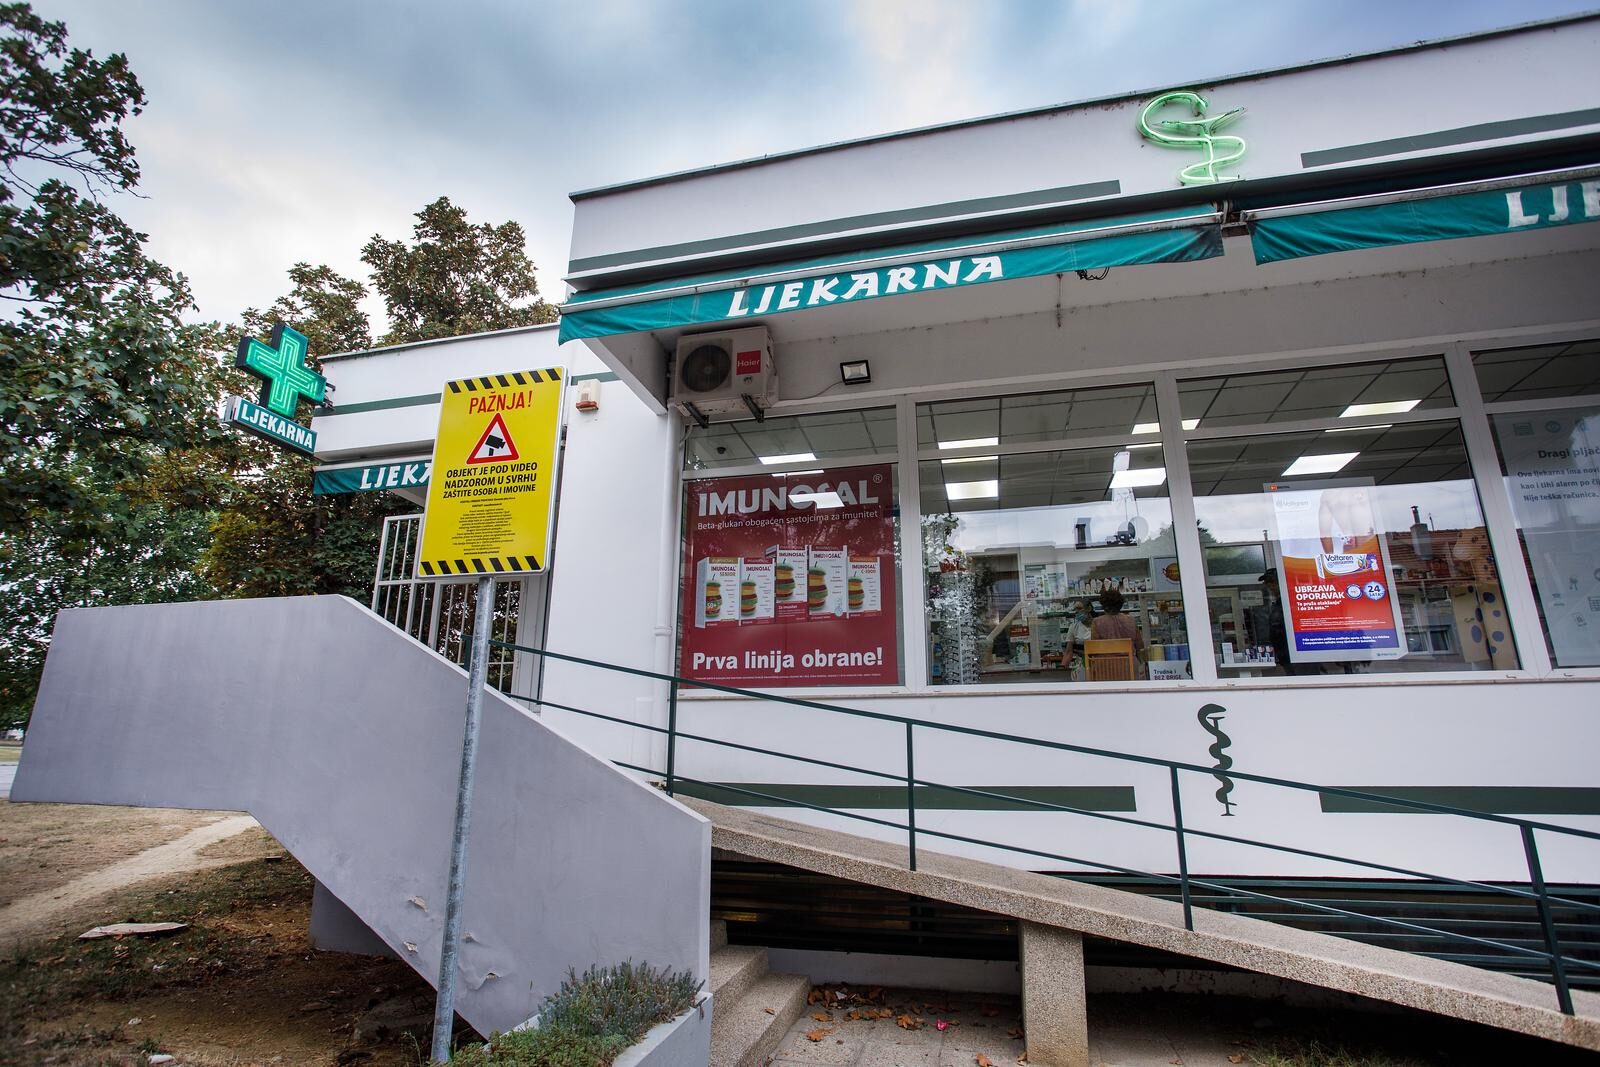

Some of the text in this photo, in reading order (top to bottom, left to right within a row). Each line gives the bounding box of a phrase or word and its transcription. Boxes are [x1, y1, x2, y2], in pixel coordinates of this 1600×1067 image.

[726, 256, 1004, 317] LJEKARNA
[240, 403, 314, 449] LJEKARNA
[1538, 448, 1570, 459] Dragi
[446, 462, 538, 478] OBJEKT JE POD VIDEO
[444, 473, 537, 489] NADZOROM U SVRHU
[1556, 480, 1579, 488] alarm
[443, 488, 472, 498] ZAŠTITE
[472, 486, 498, 496] OSOBA
[503, 484, 536, 493] IMOVINE
[697, 519, 744, 530] Beta-glukan
[745, 517, 784, 527] obogaćen
[786, 513, 829, 525] sastojcima
[842, 510, 879, 520] imunitet
[1325, 554, 1354, 562] Voltaren
[1294, 584, 1336, 593] UBRZAVA
[1367, 585, 1381, 593] 24
[1296, 591, 1345, 601] OPORAVAK
[693, 647, 883, 672] Prva linija obrane!
